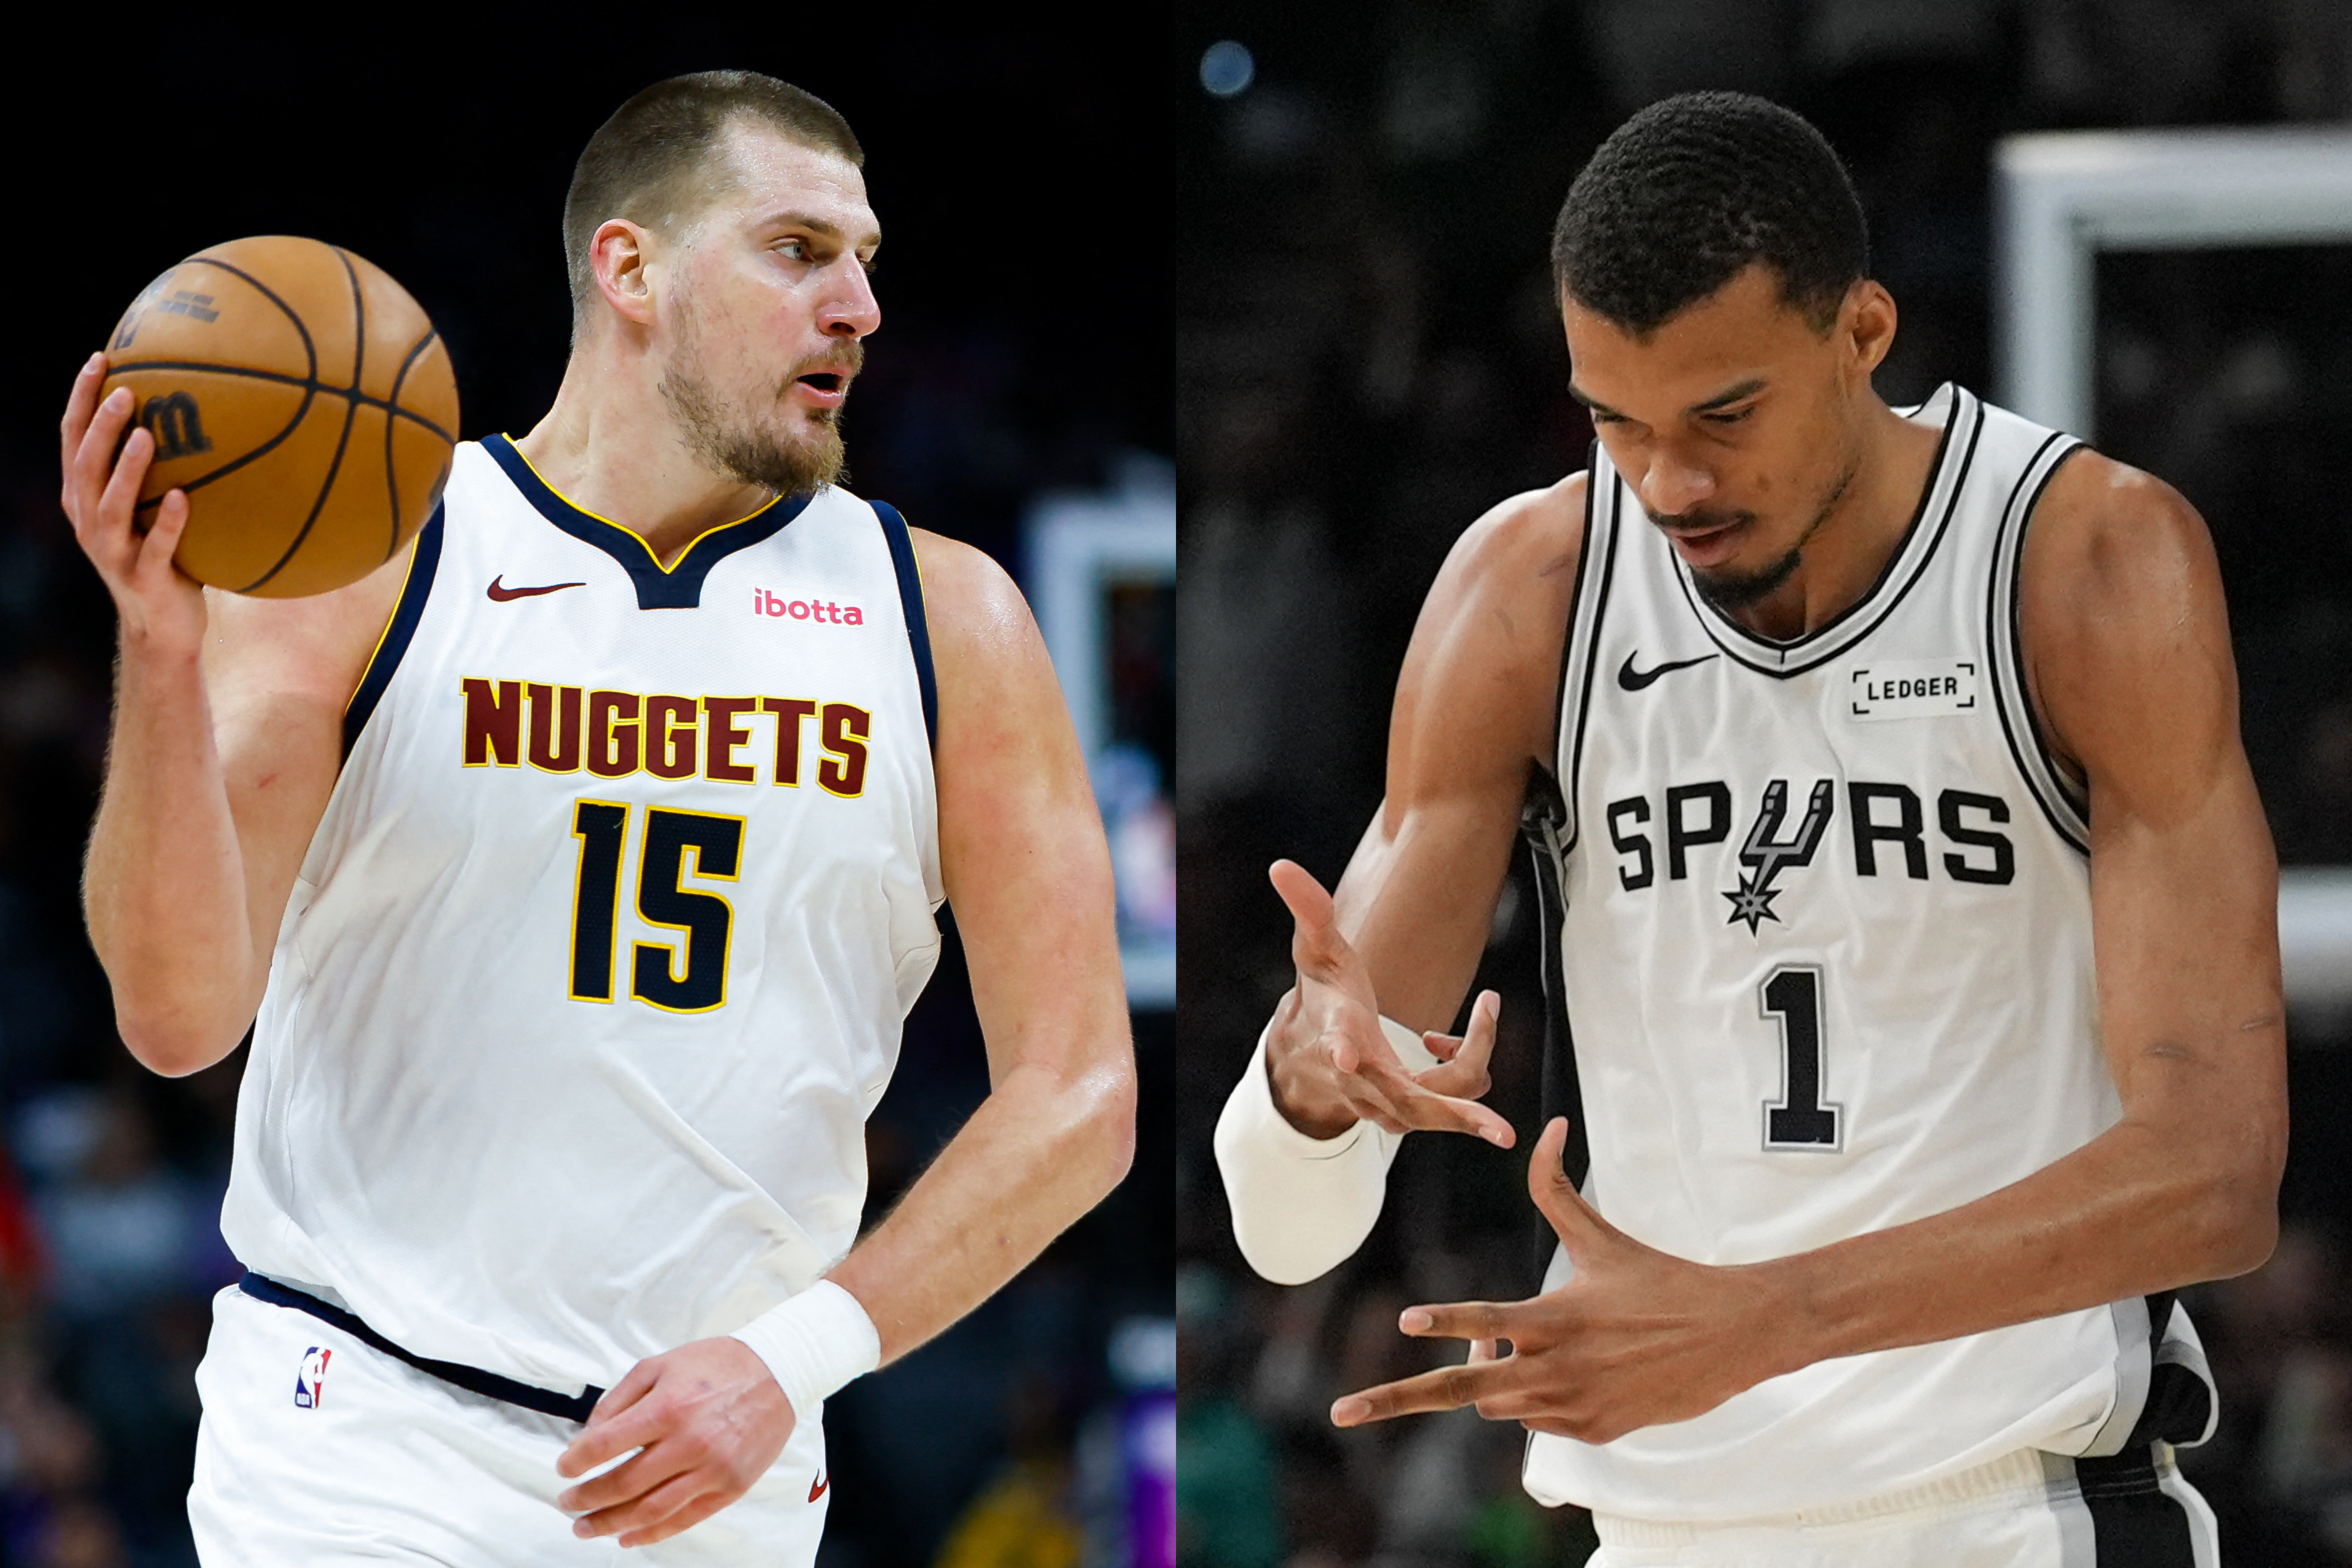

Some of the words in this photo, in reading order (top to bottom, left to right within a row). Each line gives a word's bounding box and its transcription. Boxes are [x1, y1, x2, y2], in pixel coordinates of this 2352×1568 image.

[755, 587, 864, 626] ibotta
[459, 675, 872, 799] NUGGETS
[1868, 677, 1957, 701] LEDGER
[567, 797, 748, 1014] 15
[1607, 779, 2015, 938] SPURS
[1757, 963, 1844, 1154] 1
